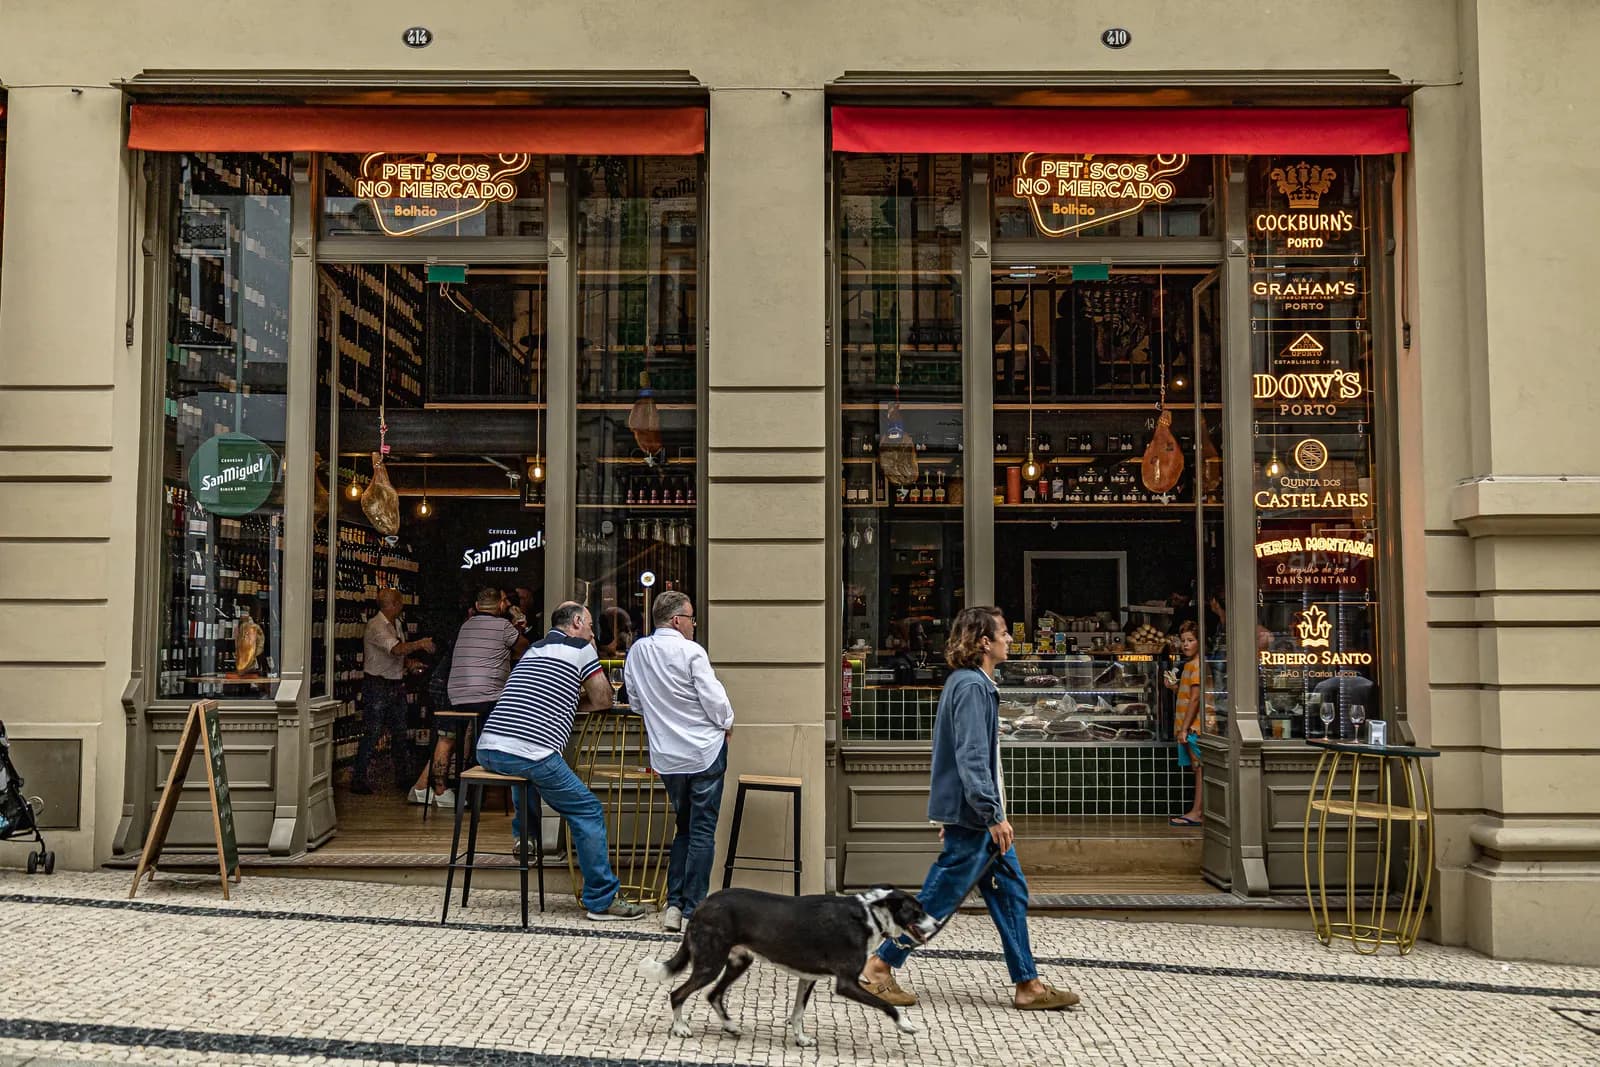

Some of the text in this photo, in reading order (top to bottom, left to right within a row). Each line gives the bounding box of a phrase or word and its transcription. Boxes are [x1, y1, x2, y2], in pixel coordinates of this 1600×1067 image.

[407, 29, 428, 44] 414
[1106, 30, 1127, 45] 410
[357, 181, 514, 199] NO MERCADO
[1016, 178, 1050, 195] NO
[1058, 180, 1173, 199] MERCADO
[394, 205, 437, 217] Bolhão
[1052, 203, 1095, 216] Bolhão
[1256, 210, 1353, 231] COCKBURN'S
[1287, 237, 1324, 248] PORTO
[1253, 281, 1356, 296] GRAHAM'S
[1285, 302, 1324, 311] PORTO
[1253, 369, 1362, 399] DOW'S
[1280, 404, 1337, 416] PORTO
[1254, 538, 1303, 558] TERRA
[1305, 537, 1374, 558] MONTANA
[1267, 576, 1357, 585] TRANSMONTANO
[1260, 651, 1372, 665] RIBEIRO SANTO
